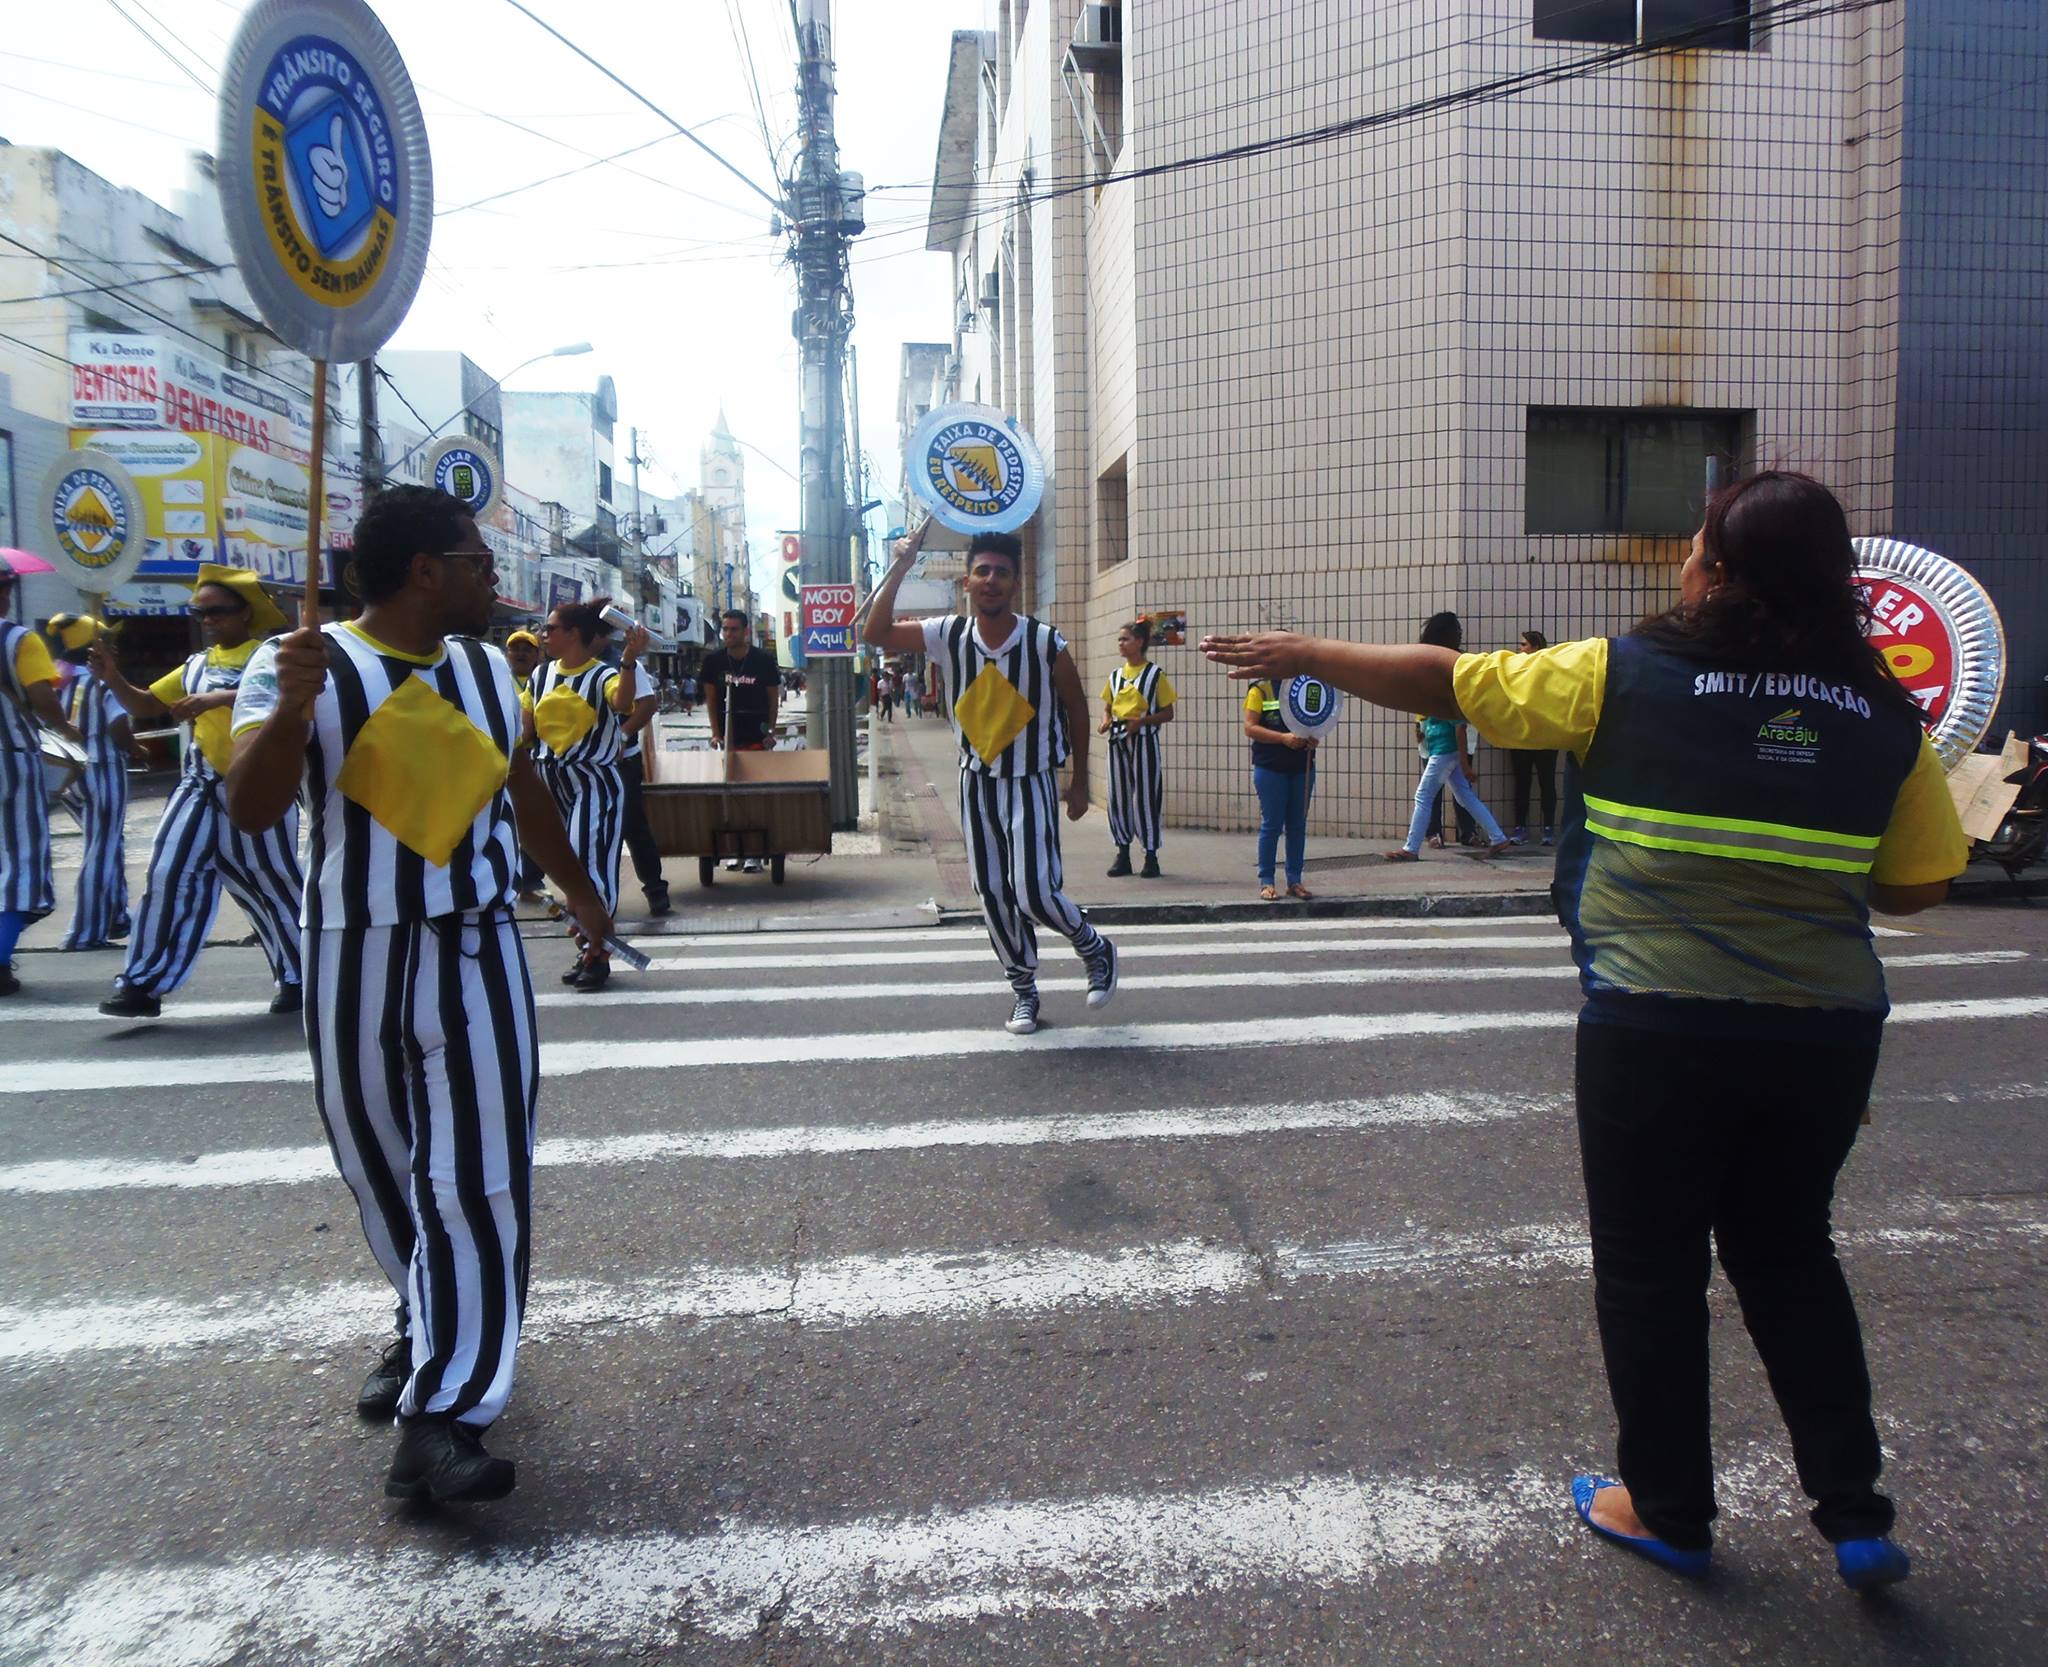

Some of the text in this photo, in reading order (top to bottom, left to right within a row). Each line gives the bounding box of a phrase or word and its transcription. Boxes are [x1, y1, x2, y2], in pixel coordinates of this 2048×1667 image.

[266, 47, 393, 204] TRÂNSITO SEGURO
[261, 149, 312, 275] TRÂNSITO
[311, 265, 341, 293] SEM
[343, 219, 390, 293] TRAUMAS
[111, 343, 155, 357] Dente
[73, 364, 158, 404] DENTISTAS
[162, 381, 270, 455] DENTISTAS
[73, 471, 88, 485] DE
[435, 451, 471, 484] CELULAR
[933, 425, 1021, 505] FAIXA DE PEDESTRE
[929, 457, 999, 513] EU RESPEITO
[804, 589, 853, 605] MOTO
[812, 608, 844, 624] BOY
[808, 630, 843, 648] Aqui
[725, 673, 756, 685] Radar
[1757, 724, 1819, 746] Aracaju
